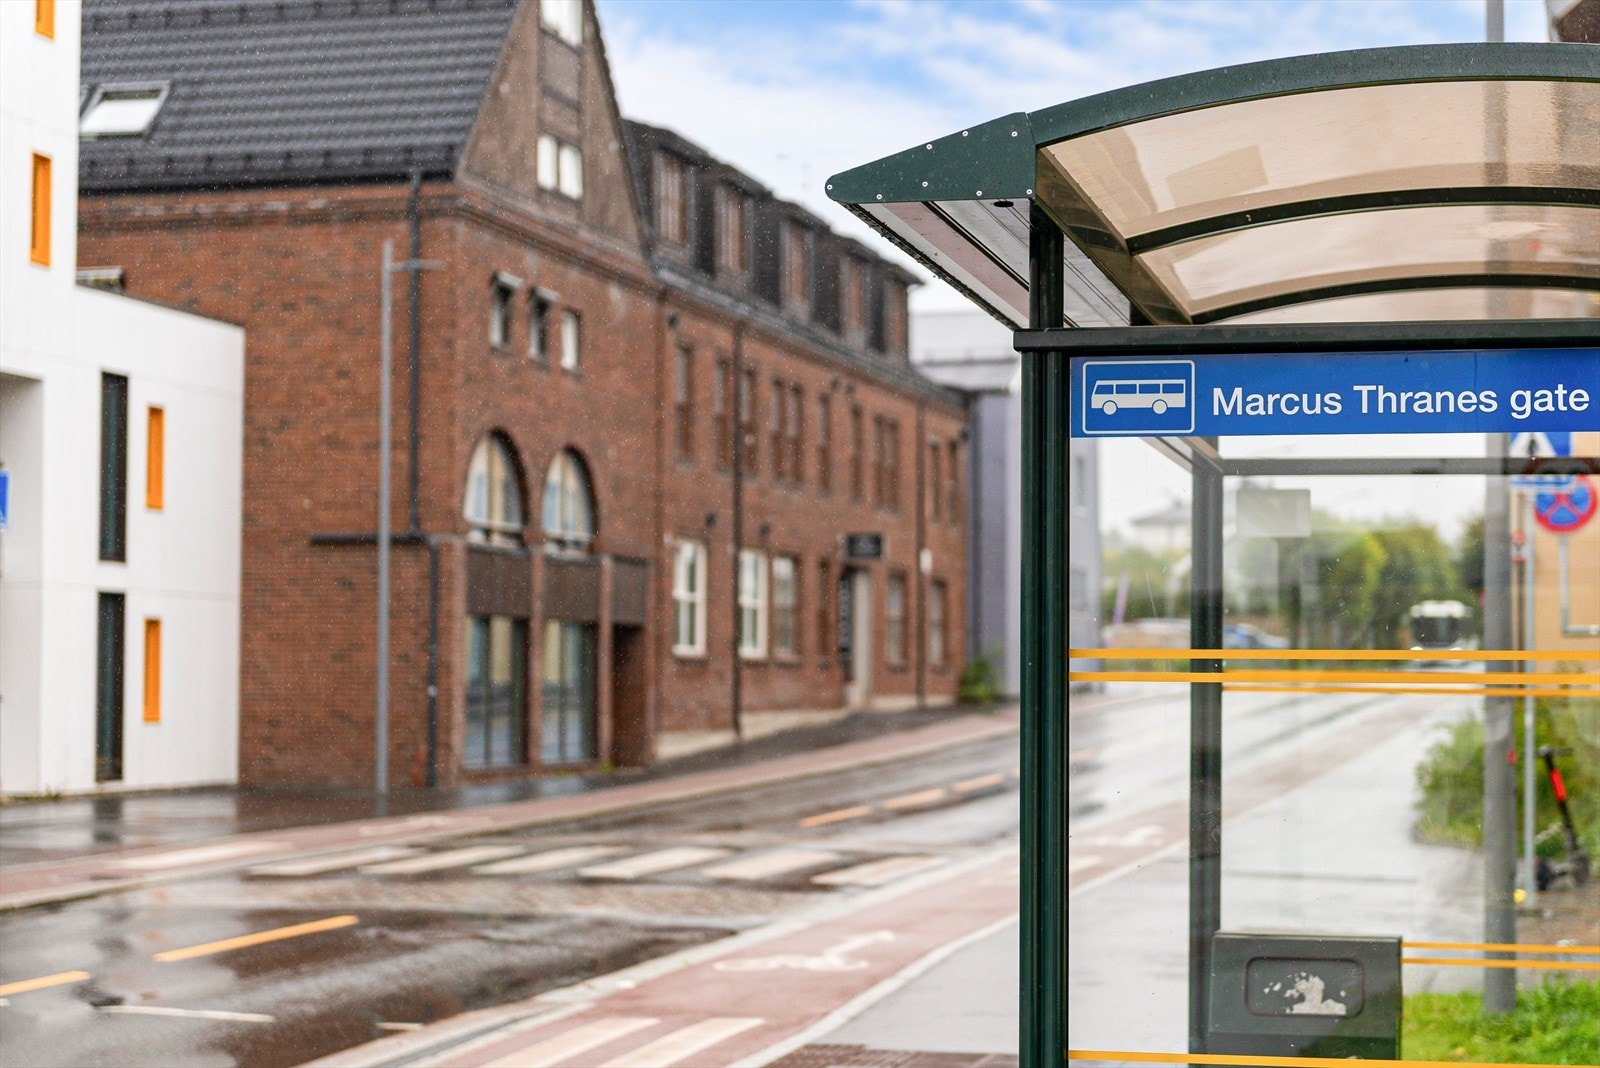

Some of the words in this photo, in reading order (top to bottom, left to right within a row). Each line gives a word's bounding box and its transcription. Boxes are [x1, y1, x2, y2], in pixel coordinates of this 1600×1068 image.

[1212, 387, 1342, 416] Marcus
[1353, 385, 1498, 414] Thranes
[1510, 383, 1590, 420] gate
